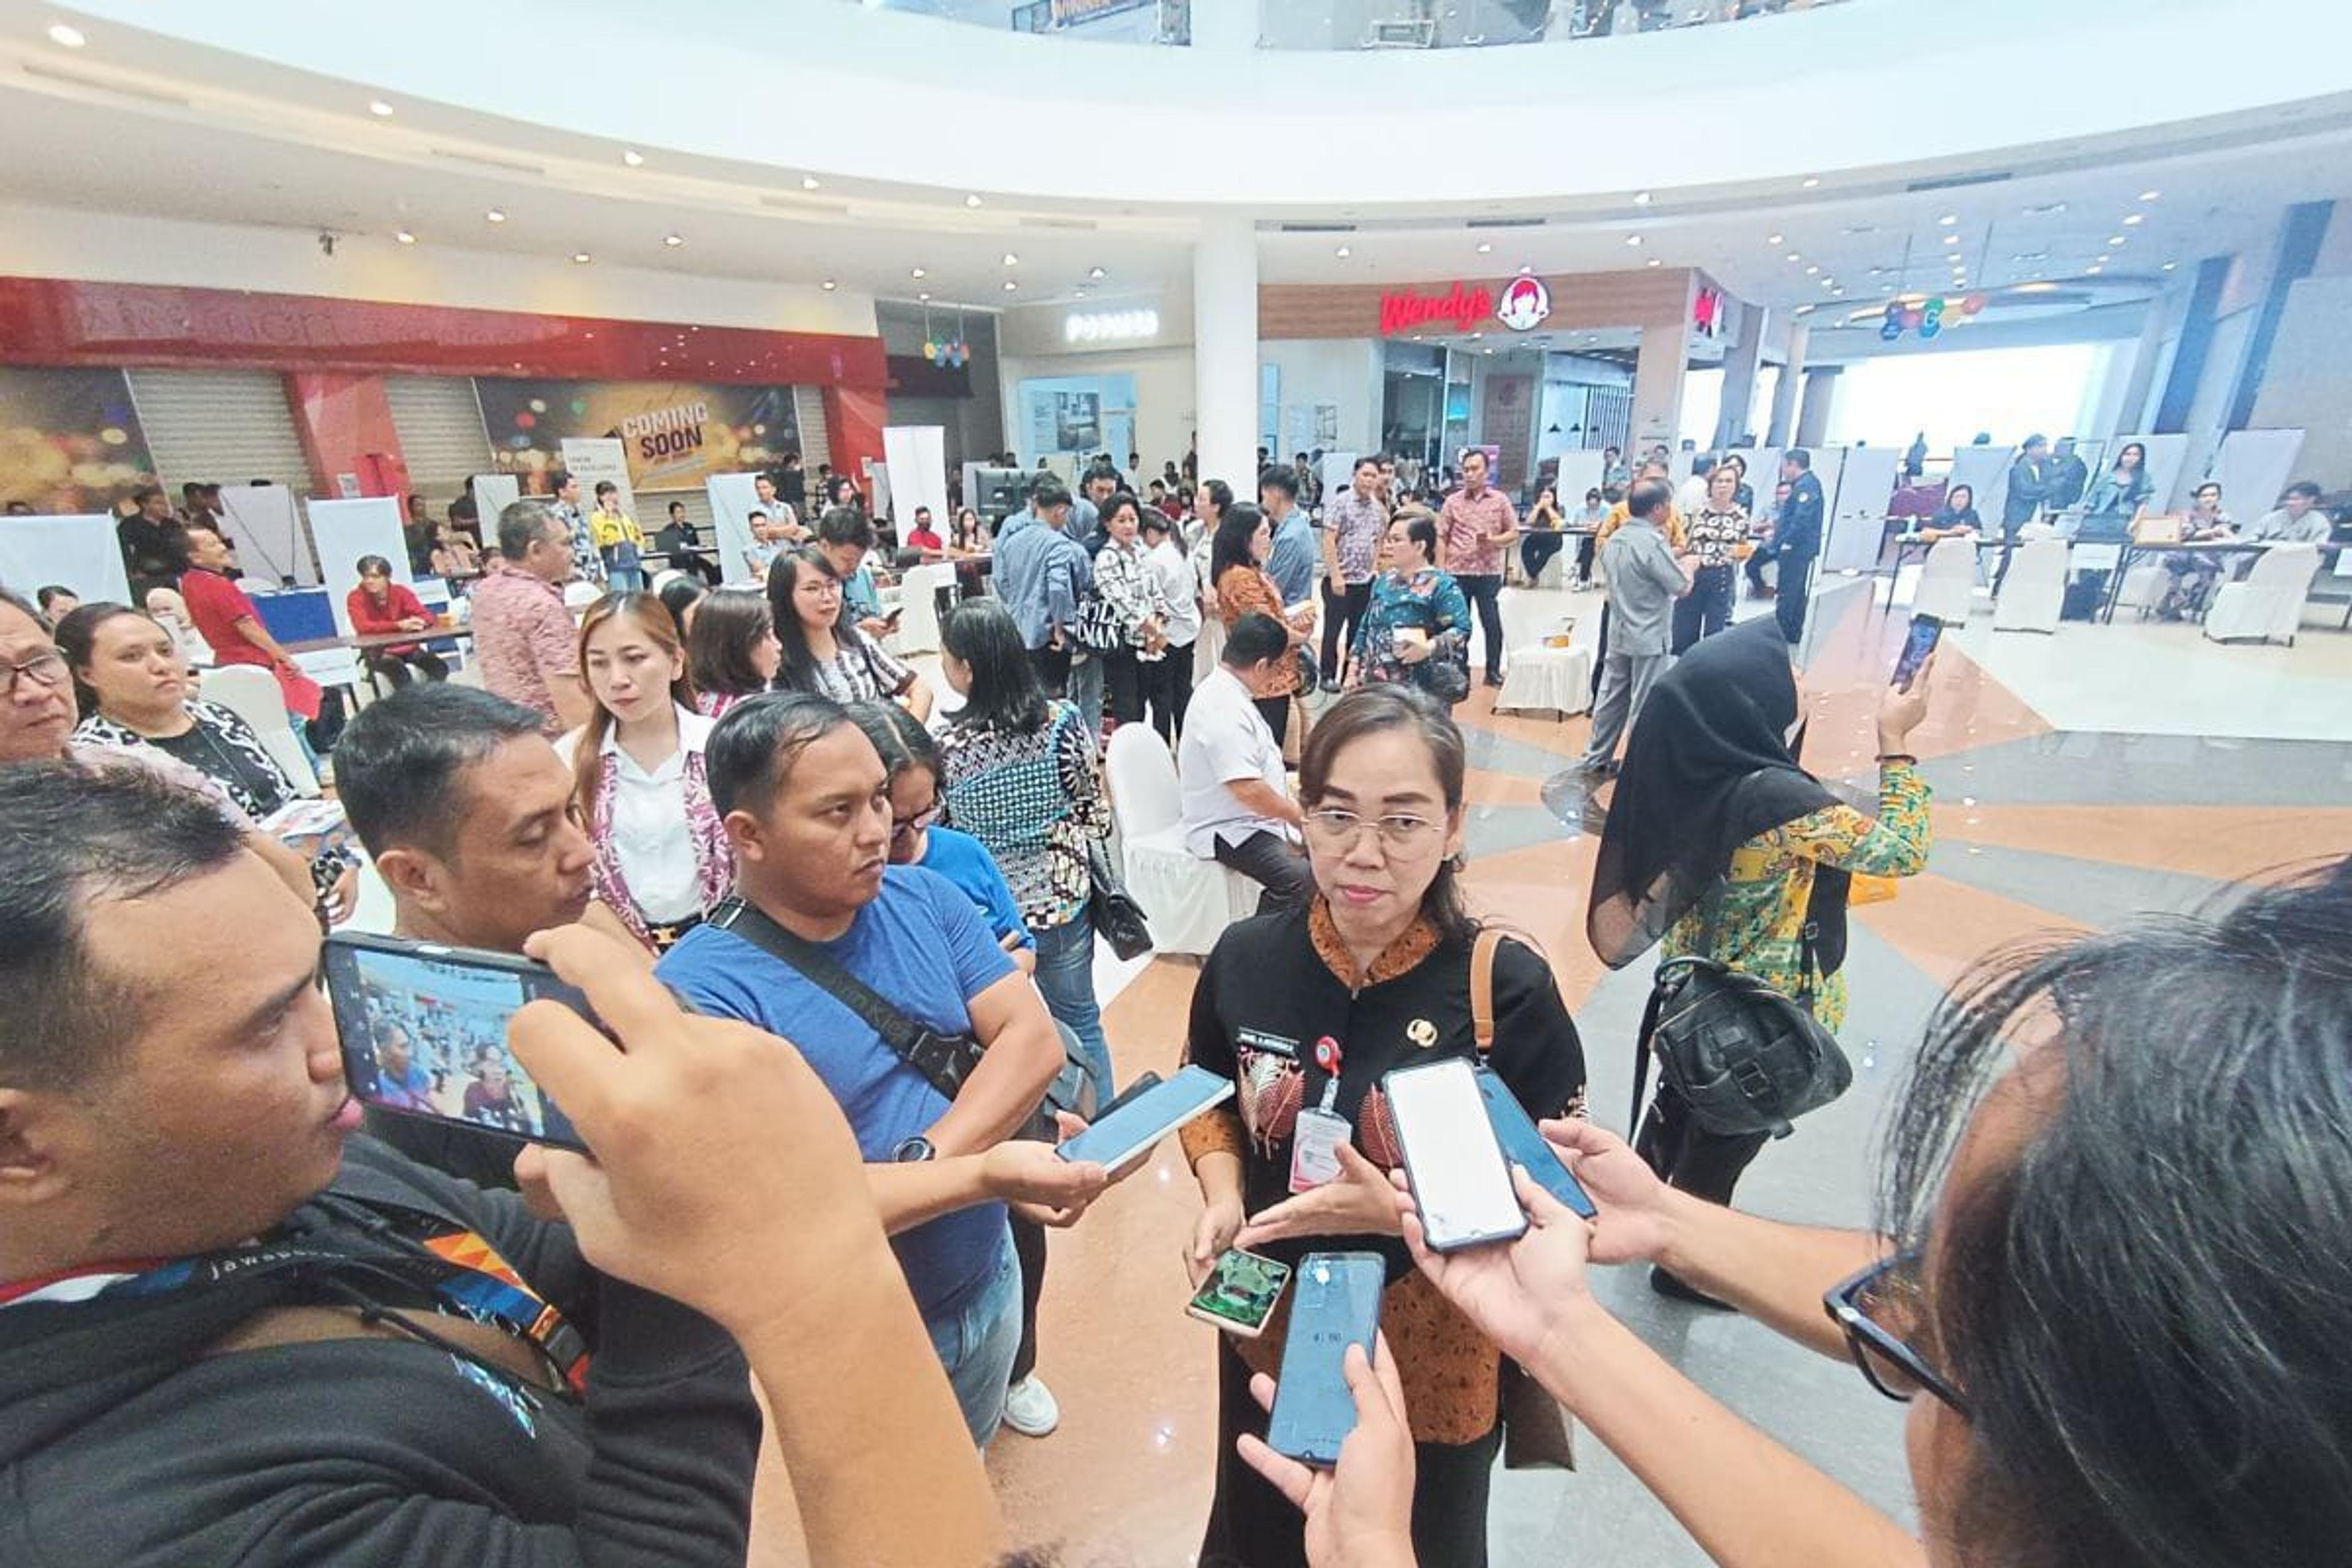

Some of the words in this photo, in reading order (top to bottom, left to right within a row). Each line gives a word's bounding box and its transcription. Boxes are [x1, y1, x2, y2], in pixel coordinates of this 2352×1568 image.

[1382, 282, 1492, 335] Wendy's
[622, 401, 708, 438] COMING
[641, 425, 703, 459] SOON
